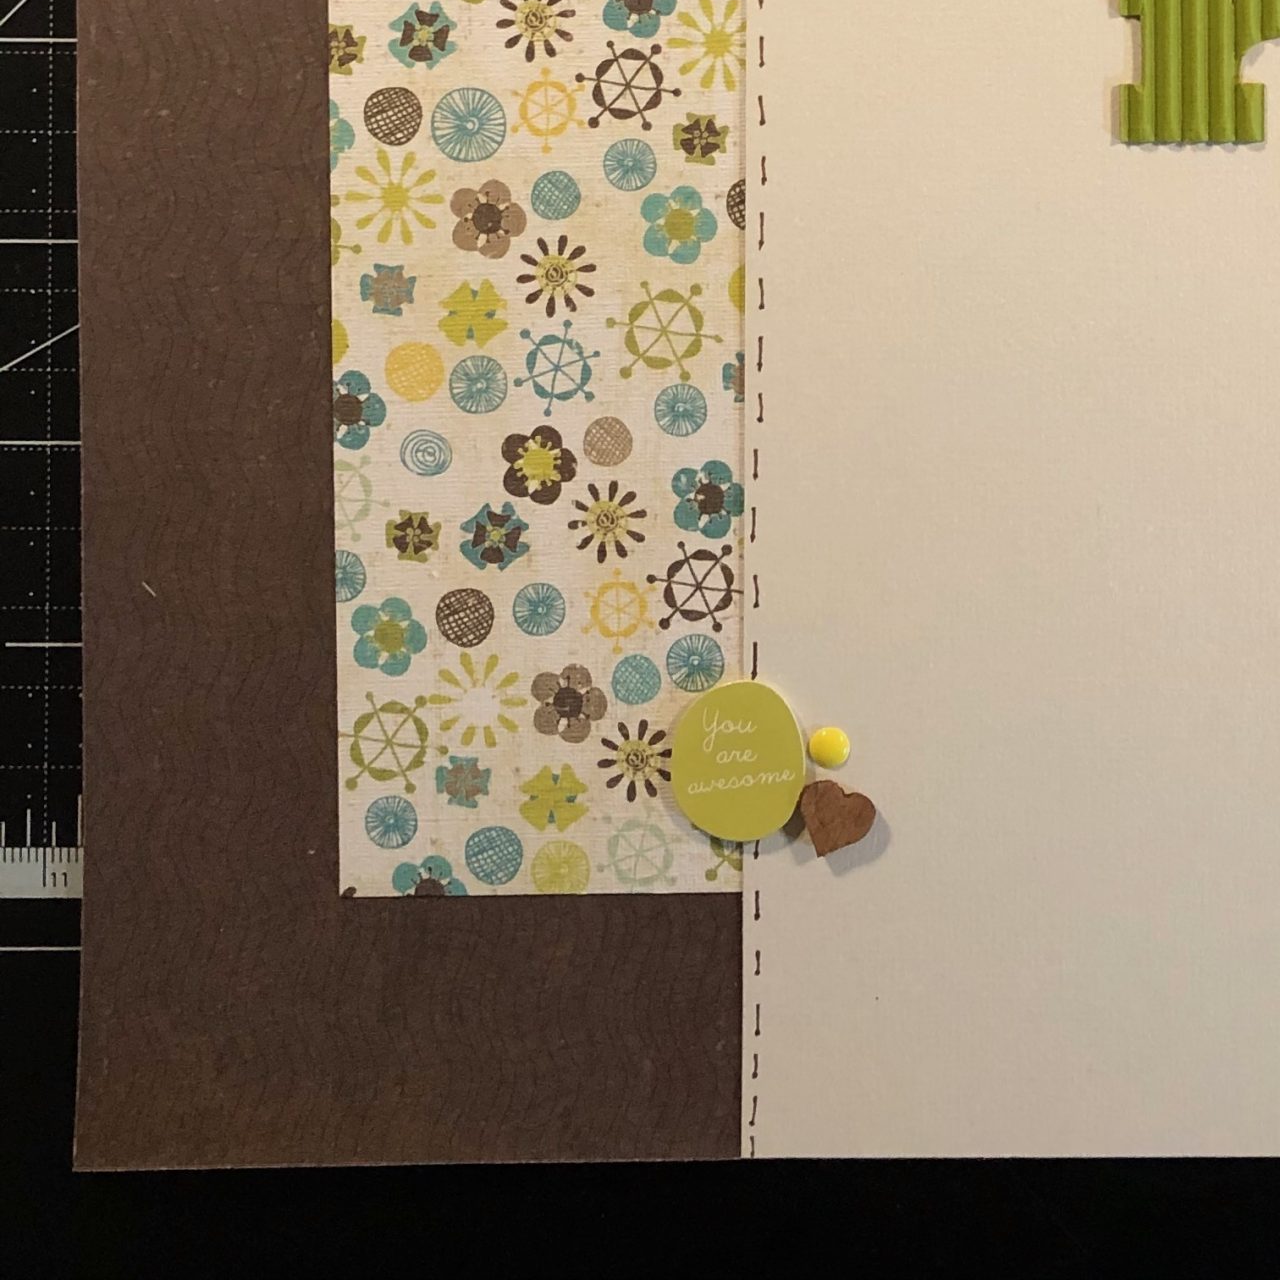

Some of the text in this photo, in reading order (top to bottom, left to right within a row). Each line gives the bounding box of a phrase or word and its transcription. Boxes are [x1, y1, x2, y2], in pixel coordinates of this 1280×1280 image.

[702, 706, 758, 753] You
[715, 748, 758, 765] are
[687, 769, 796, 796] awesome
[50, 871, 68, 888] 11
